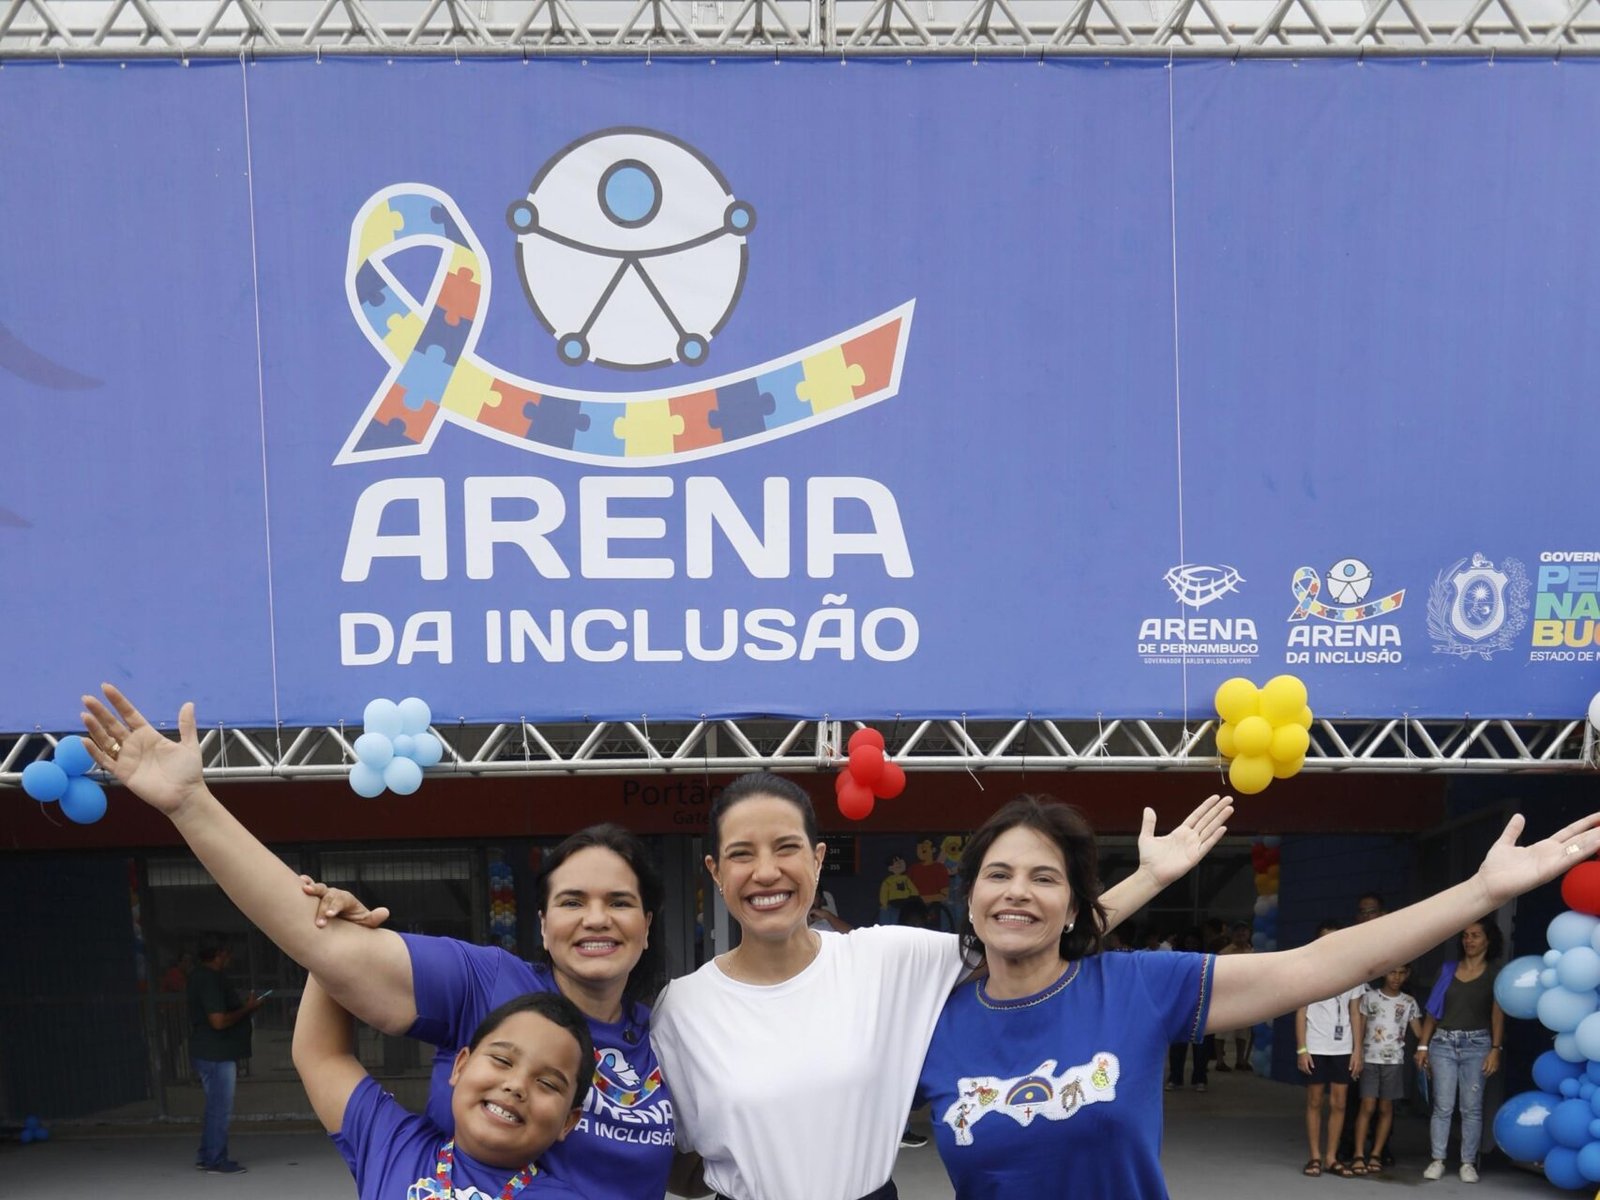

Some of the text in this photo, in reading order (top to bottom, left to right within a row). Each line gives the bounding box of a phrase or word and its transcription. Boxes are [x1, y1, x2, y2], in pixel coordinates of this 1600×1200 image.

[340, 476, 915, 582] ARENA
[1537, 566, 1600, 592] PE
[339, 593, 921, 666] DA INCLUSÃO
[1138, 618, 1258, 640] ARENA
[1287, 624, 1402, 647] ARENA
[1532, 620, 1600, 647] BU
[1138, 643, 1259, 653] DE PERNAMBUCO
[1286, 648, 1402, 664] DA INCLUSÃO
[1530, 652, 1575, 661] ESTADO
[1578, 652, 1593, 661] DE
